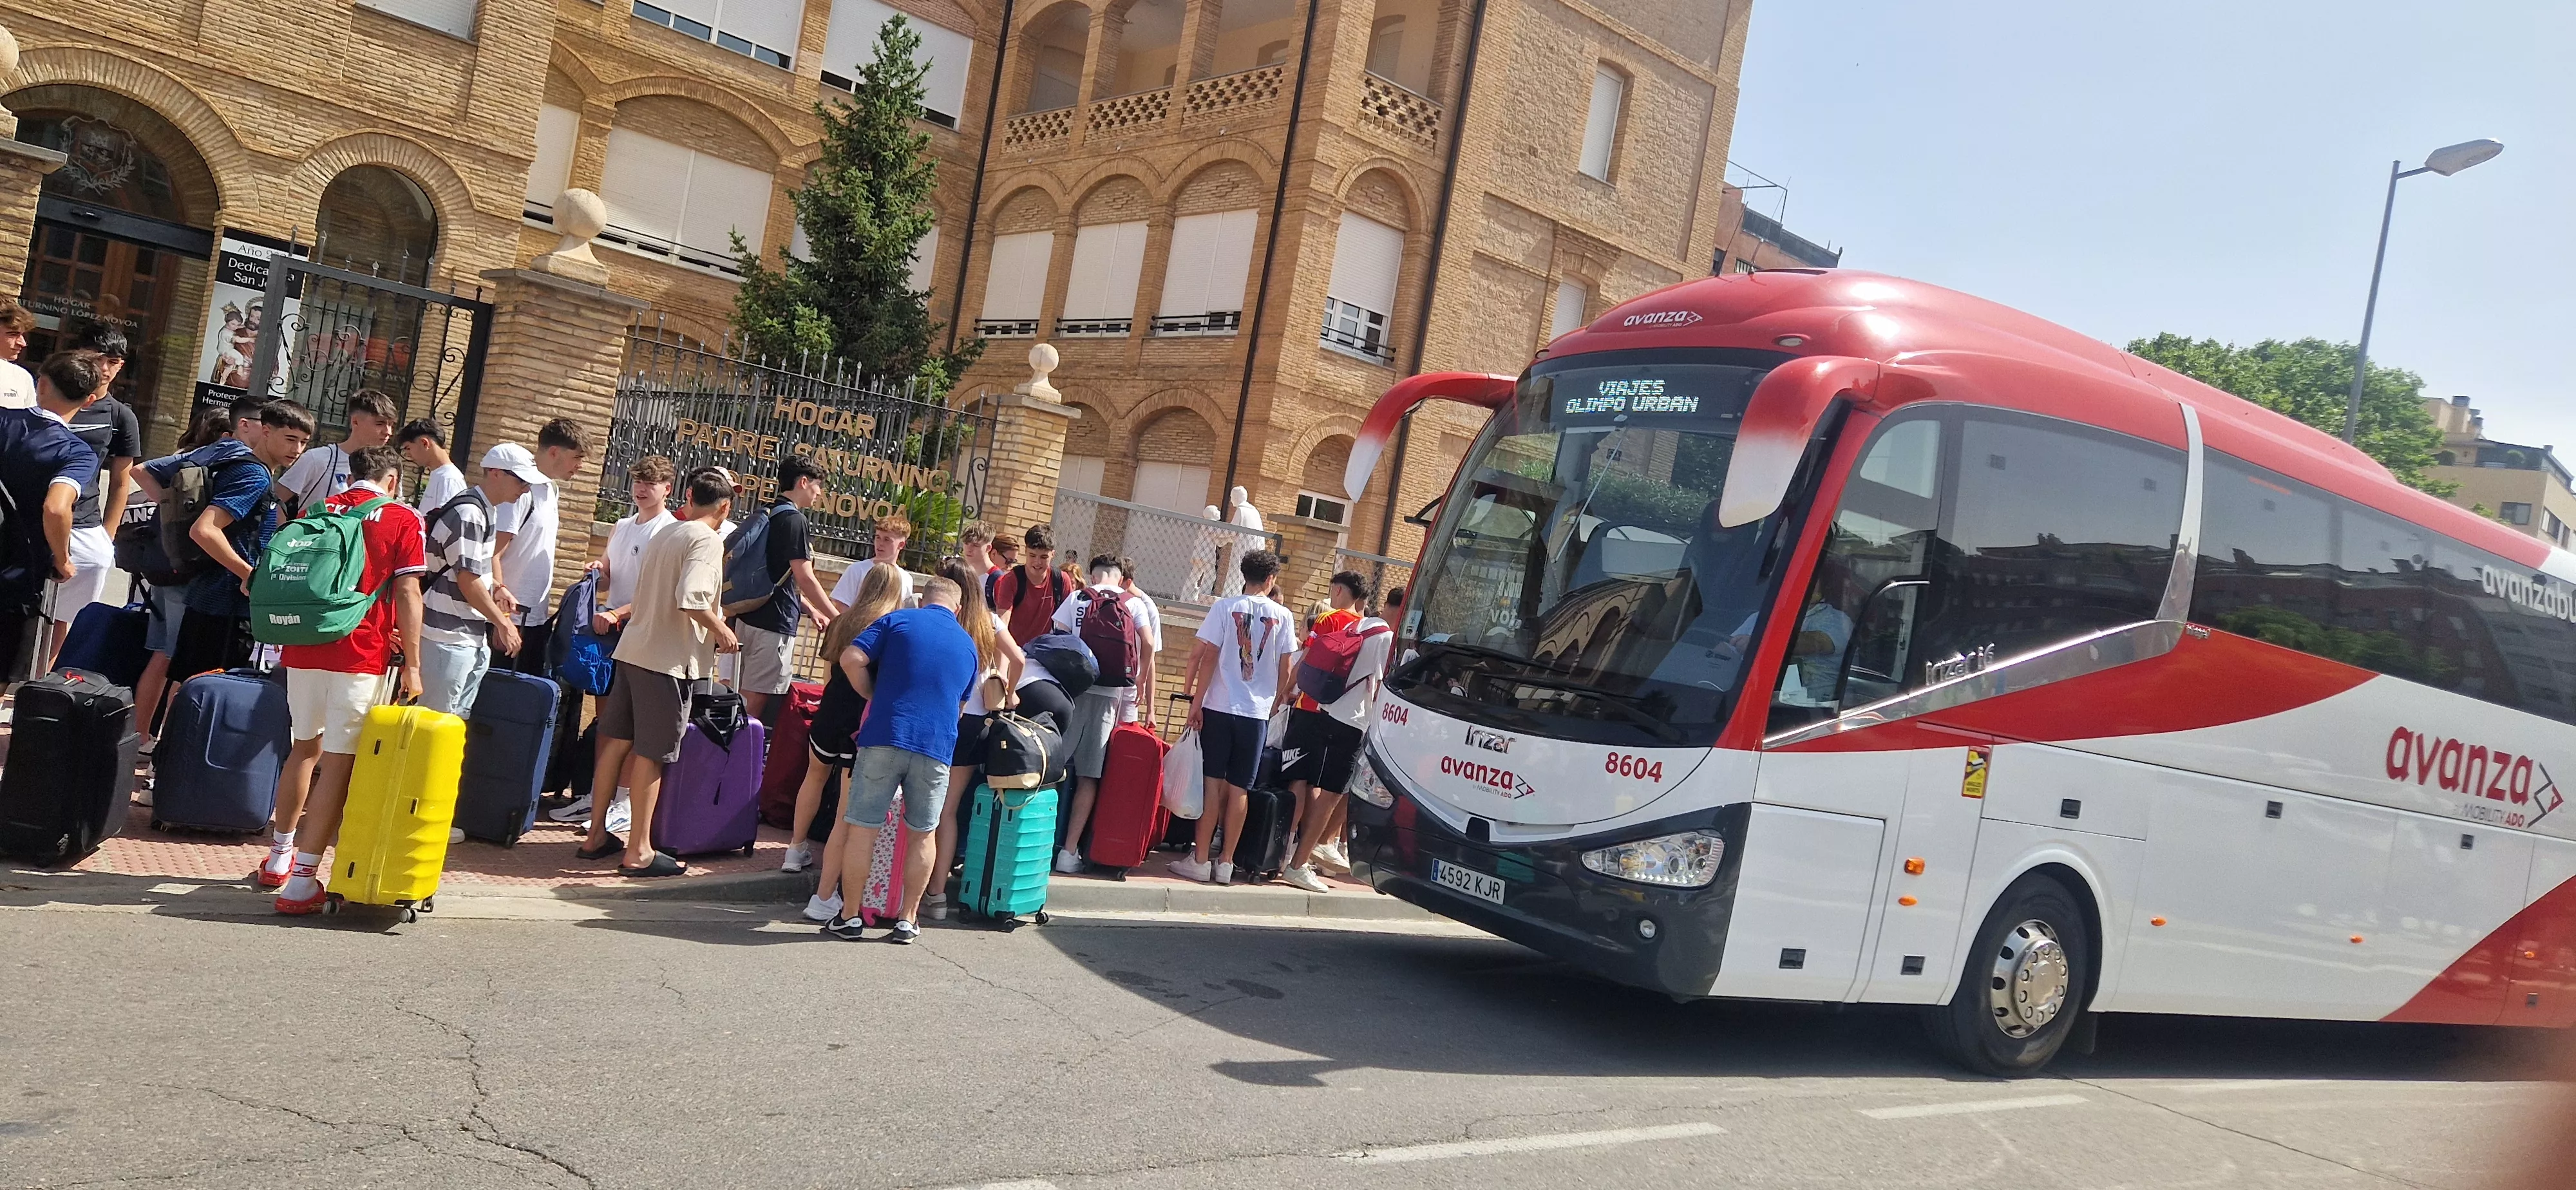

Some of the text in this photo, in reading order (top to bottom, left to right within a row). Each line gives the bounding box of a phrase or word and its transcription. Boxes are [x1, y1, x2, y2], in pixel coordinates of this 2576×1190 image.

[238, 244, 262, 258] Año
[228, 258, 269, 276] Dedica
[233, 271, 255, 285] San
[53, 295, 91, 309] HOGAR
[103, 314, 138, 328] NOVOA
[1624, 310, 1688, 326] avanza
[1598, 379, 1666, 396] VIAJES
[1566, 395, 1700, 413] OLIMPO URBAN
[773, 395, 876, 439] HOGAR
[676, 417, 947, 493] PADRE SATURNINO
[813, 487, 908, 522] NOVOA
[269, 613, 301, 626] Royán
[1382, 702, 1409, 726] 8604
[1282, 748, 1301, 762] NIKE
[1441, 751, 1663, 791] avanza 8604
[2385, 726, 2534, 806] avanza
[1476, 784, 1500, 795] MOBILITY
[2506, 813, 2525, 828] ADO
[1440, 865, 1501, 900] 4592 KJR
